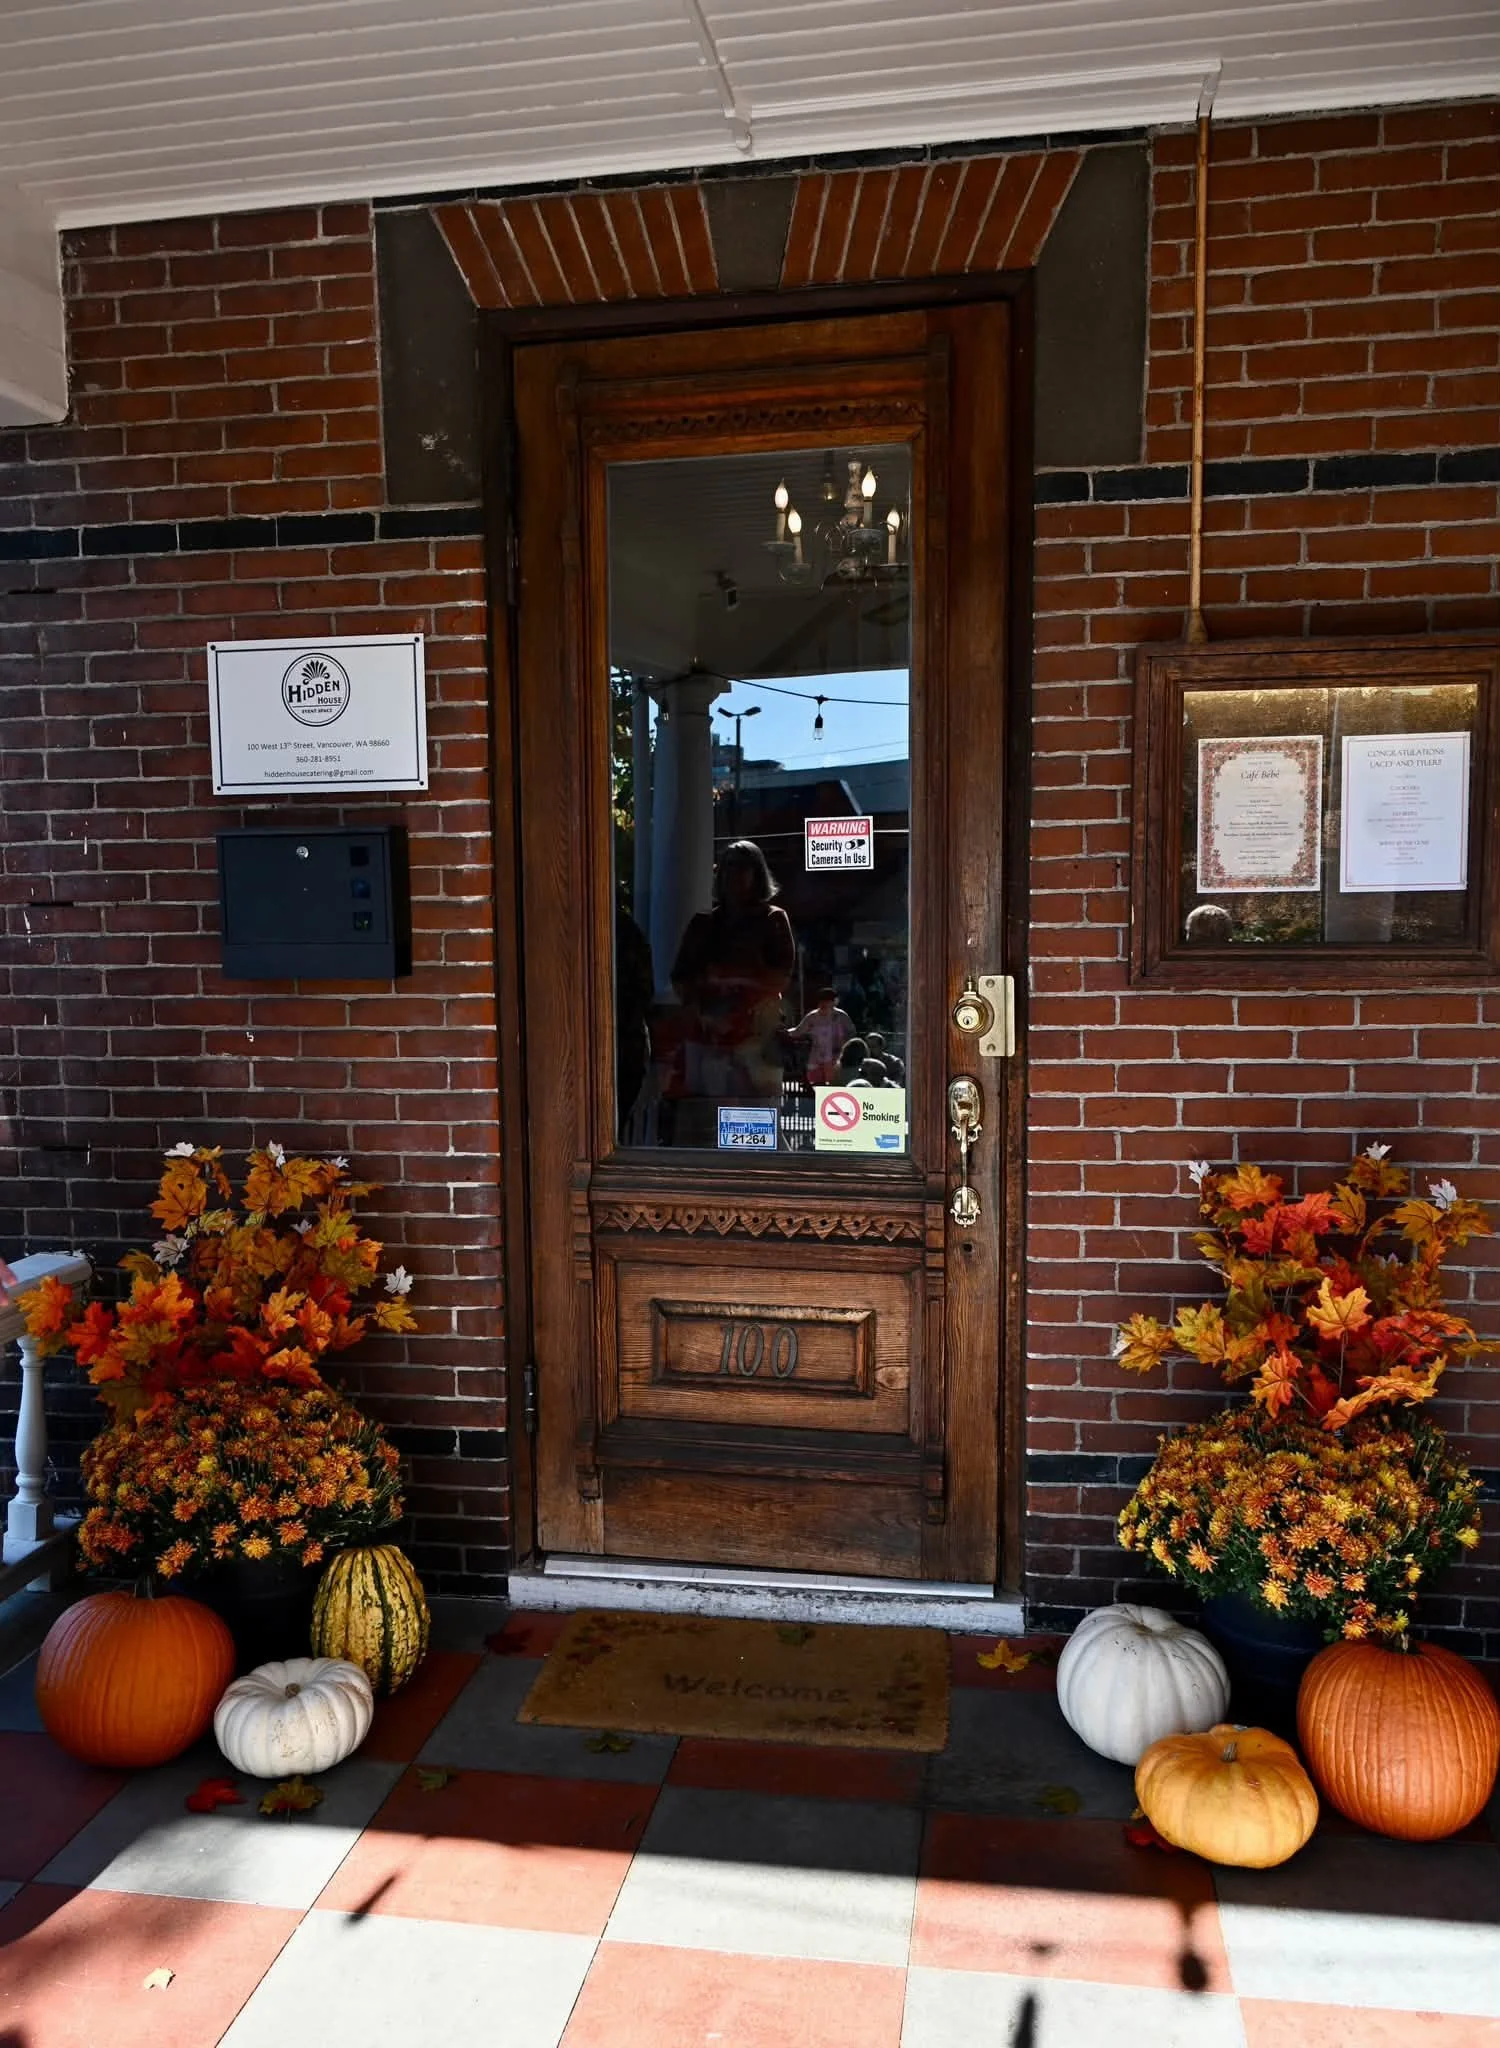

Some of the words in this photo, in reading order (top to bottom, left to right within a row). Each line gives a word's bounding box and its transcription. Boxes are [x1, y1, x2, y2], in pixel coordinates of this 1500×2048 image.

[288, 680, 340, 703] HIDDEN
[247, 743, 260, 751] 100
[293, 741, 315, 750] Street,
[316, 741, 354, 749] Vancouver,
[355, 740, 368, 748] WA
[368, 739, 390, 747] 98660
[295, 755, 341, 763] 360-281-8951
[811, 822, 866, 835] WARNING
[811, 839, 843, 852] Security
[811, 854, 843, 865] Cameras
[844, 853, 851, 864] In
[853, 853, 867, 864] Use
[862, 1101, 875, 1111] No
[862, 1112, 900, 1124] Smoking
[731, 1134, 767, 1145] 21264
[719, 1324, 798, 1378] 100
[663, 1673, 850, 1703] Welcome
